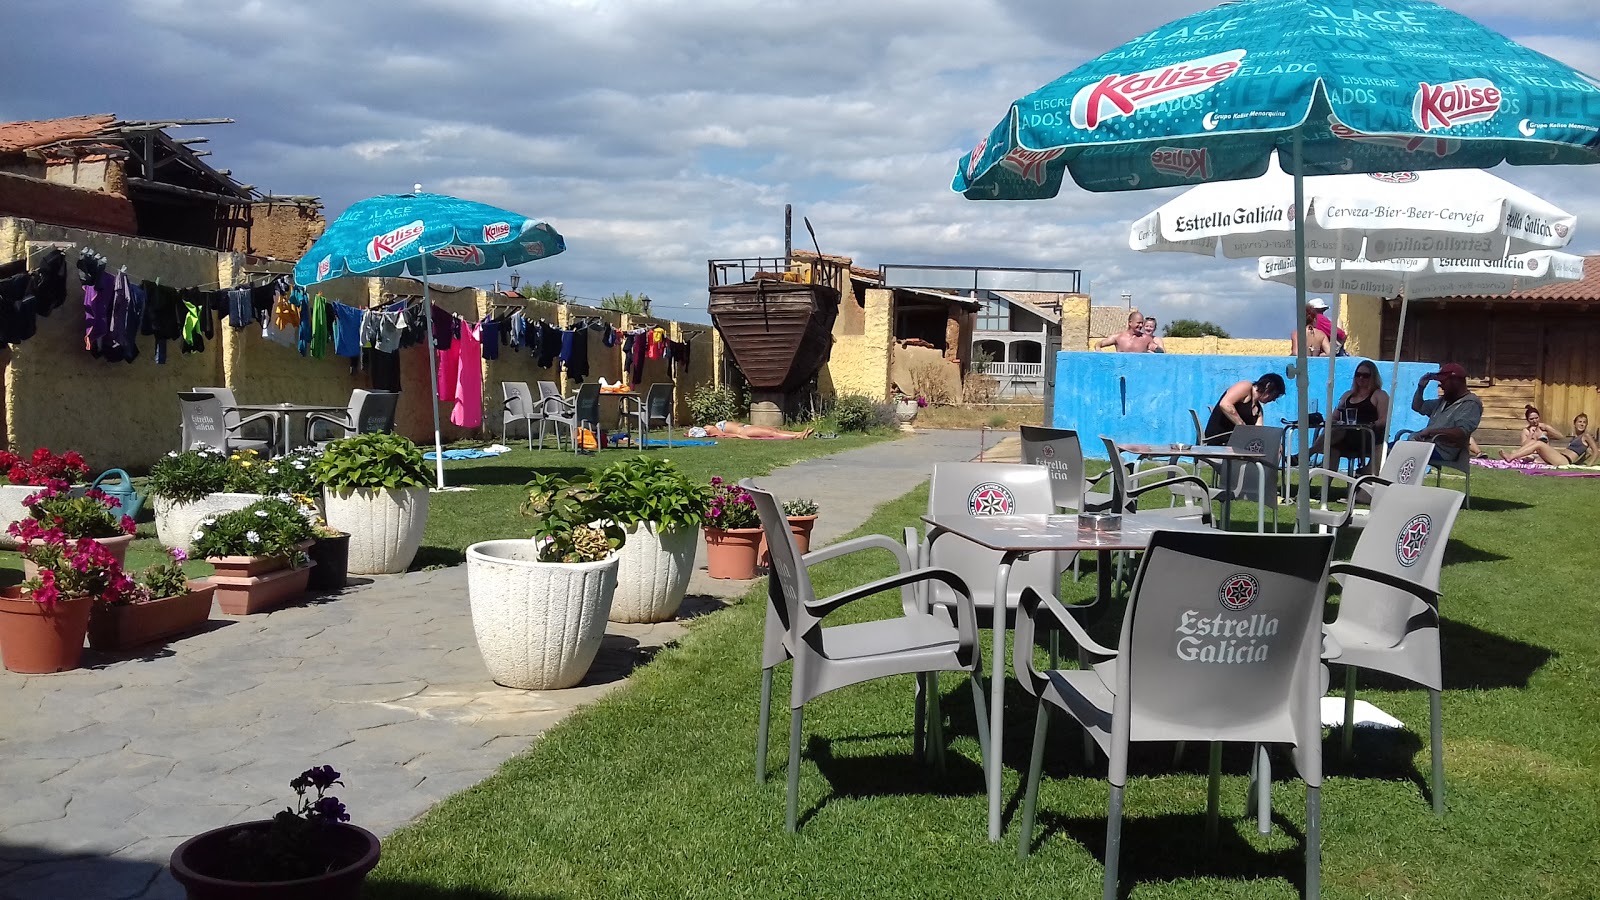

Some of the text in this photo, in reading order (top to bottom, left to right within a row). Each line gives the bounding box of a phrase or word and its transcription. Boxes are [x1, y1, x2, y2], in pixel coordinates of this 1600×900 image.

[1332, 20, 1364, 29] ICE
[1367, 23, 1430, 34] CREAM
[1131, 32, 1225, 51] ICE CREAM
[1093, 49, 1147, 62] EAM
[1232, 63, 1318, 77] ELADO
[1341, 75, 1400, 87] EISCREME
[1509, 74, 1600, 94] HELAD
[1086, 61, 1240, 128] Kalise
[1330, 87, 1378, 105] ADOS
[1420, 83, 1500, 131] Kalise
[1021, 112, 1064, 129] ADOS
[1174, 205, 1283, 233] Estrella Galicia
[1326, 205, 1485, 228] Cerveza-Bier-Beer-Cerveja
[484, 223, 510, 242] Kalise
[373, 226, 423, 261] Kalise
[1175, 609, 1280, 638] Estrella
[1176, 636, 1270, 664] Galicia
